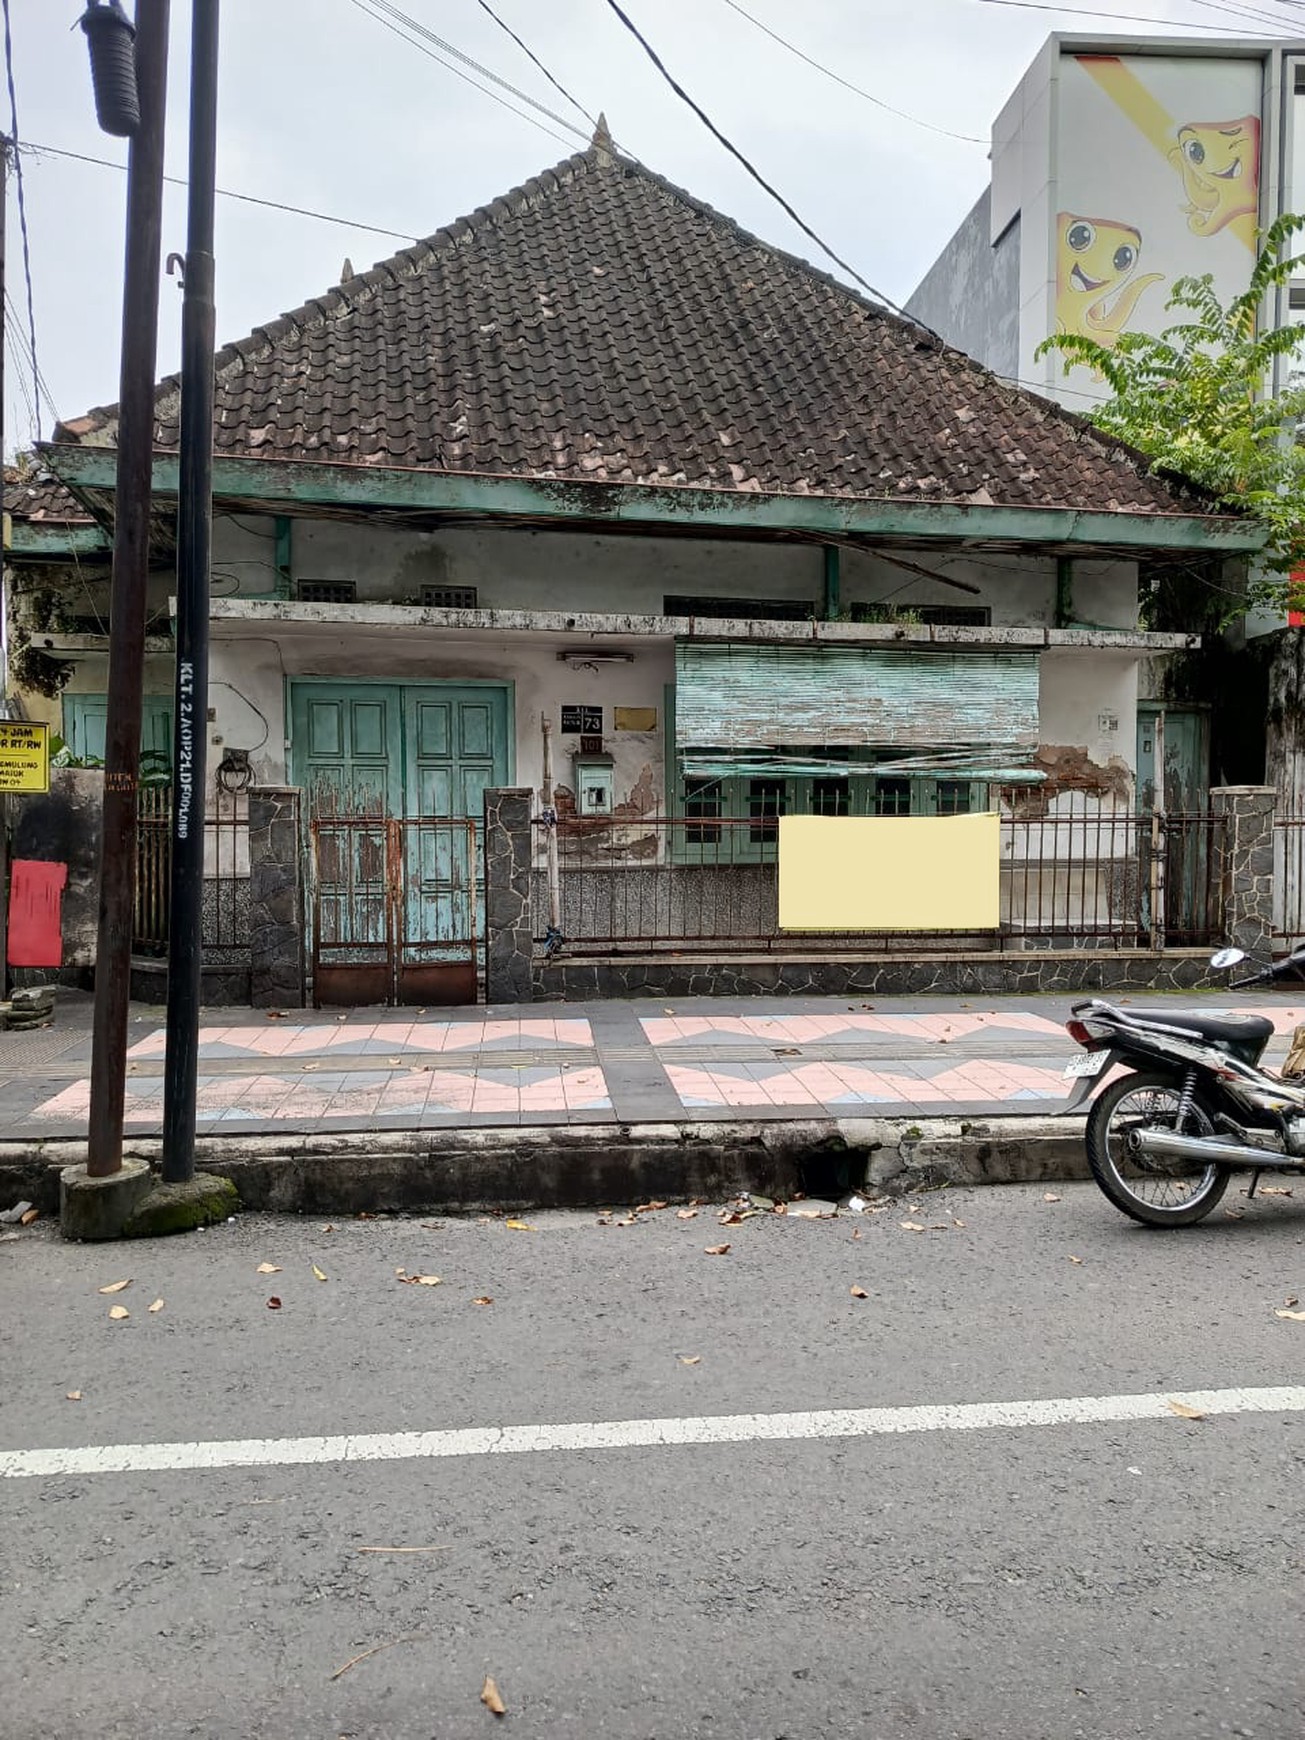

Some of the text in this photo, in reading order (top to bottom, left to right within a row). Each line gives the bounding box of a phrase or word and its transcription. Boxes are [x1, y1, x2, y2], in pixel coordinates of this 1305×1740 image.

[584, 717, 600, 729] 73
[11, 728, 33, 737] JAM
[10, 739, 42, 749] RT/RW
